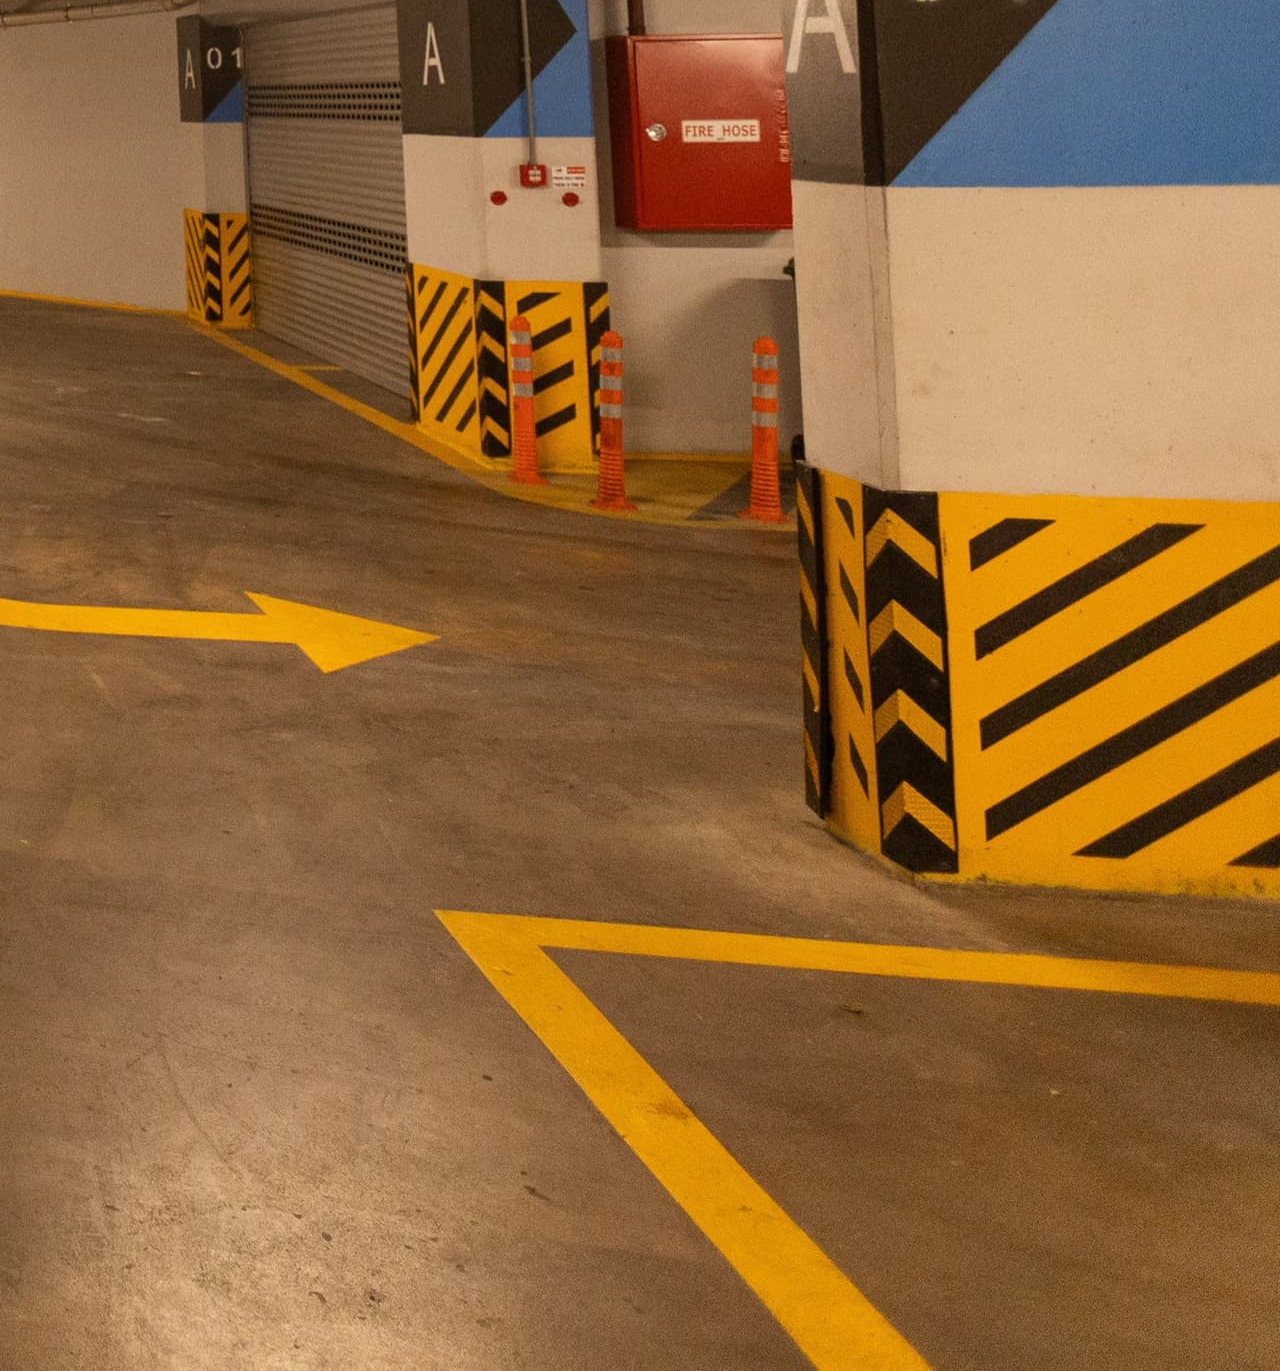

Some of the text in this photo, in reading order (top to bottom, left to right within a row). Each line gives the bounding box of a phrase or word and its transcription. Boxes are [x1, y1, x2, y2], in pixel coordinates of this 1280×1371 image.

[184, 48, 196, 90] A
[207, 47, 241, 69] 01
[422, 21, 445, 86] A
[684, 124, 757, 138] FIRE HOSE
